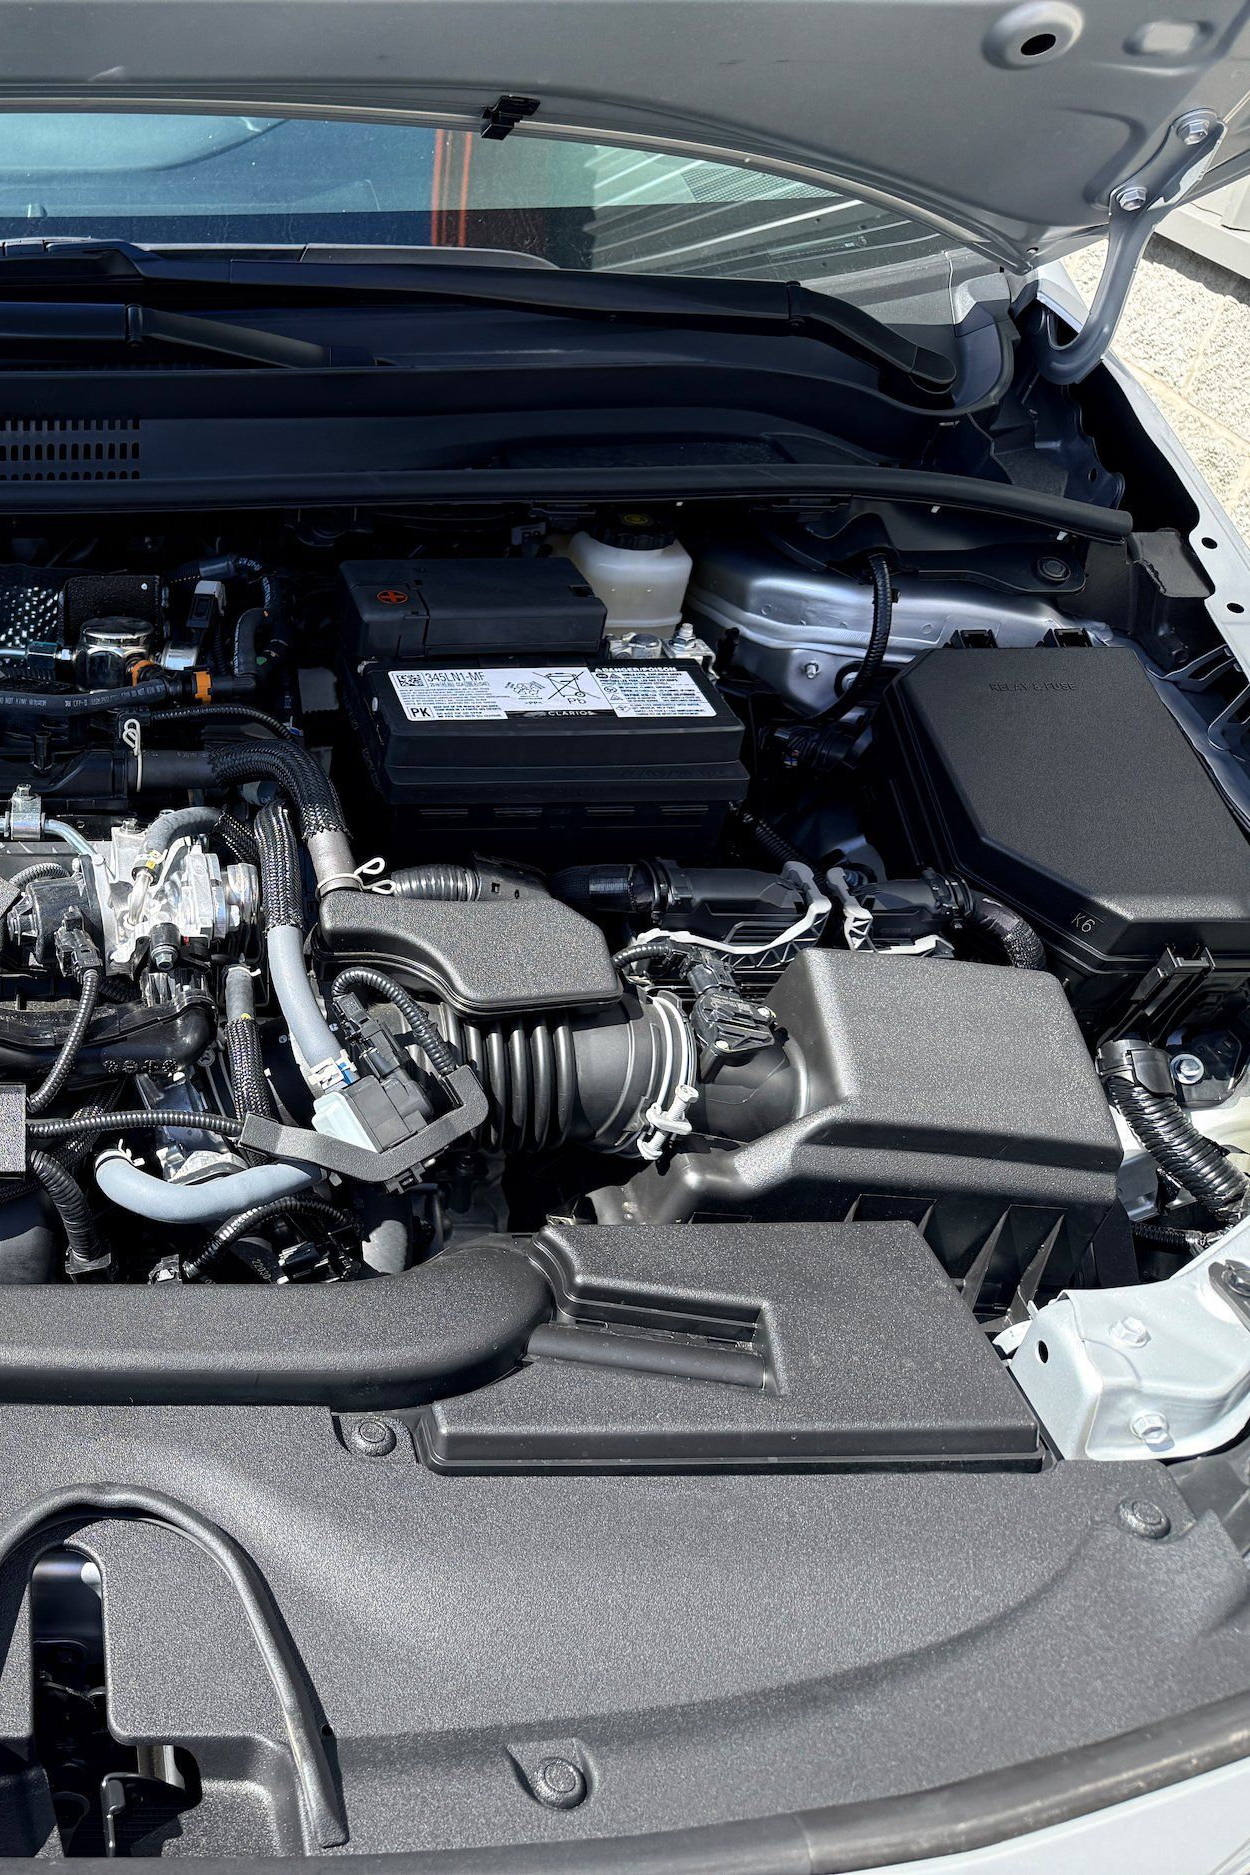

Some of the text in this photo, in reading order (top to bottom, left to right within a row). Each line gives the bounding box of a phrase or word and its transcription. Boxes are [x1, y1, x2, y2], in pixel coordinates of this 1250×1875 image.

[425, 672, 485, 682] 345LN1-MF
[989, 682, 1028, 691] RELAY
[1043, 682, 1077, 691] FUSE
[567, 697, 586, 705] Pb
[410, 707, 431, 717] PK
[1071, 912, 1096, 932] K6
